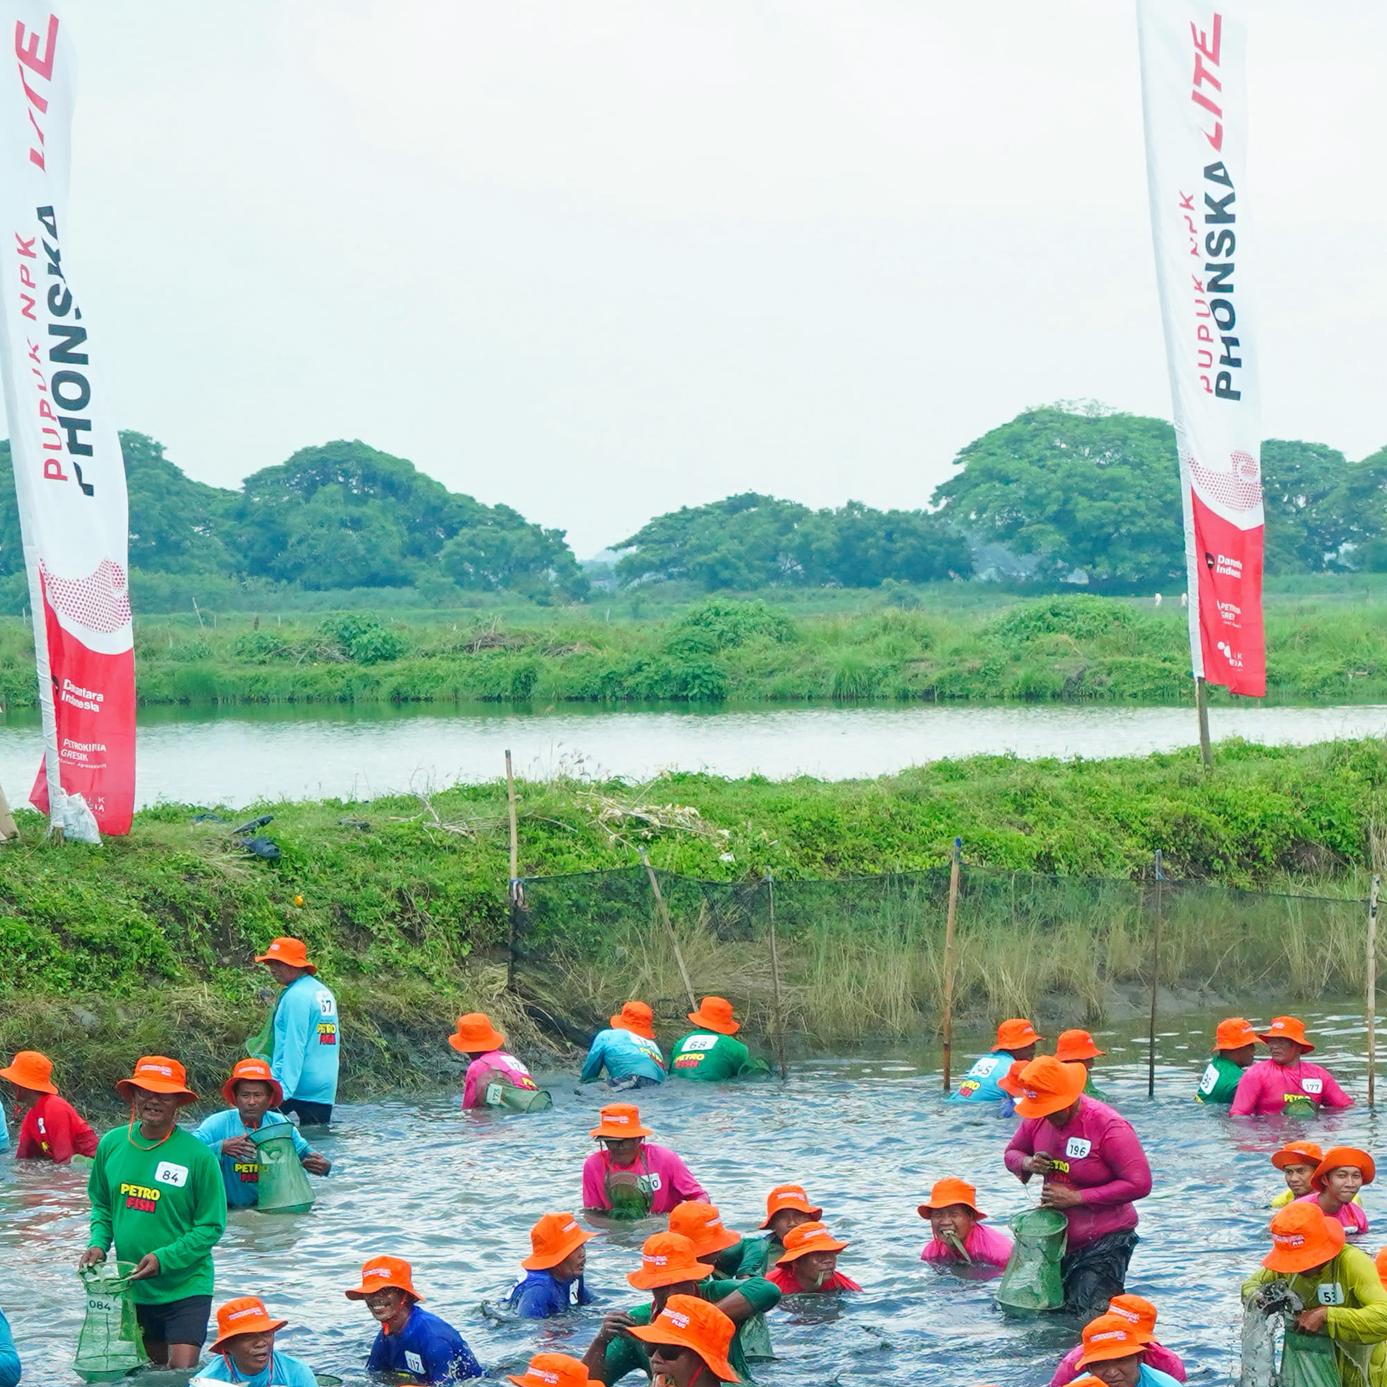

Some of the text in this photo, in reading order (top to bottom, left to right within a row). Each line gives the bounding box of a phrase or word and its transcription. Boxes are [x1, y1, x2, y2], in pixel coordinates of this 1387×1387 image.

[1191, 12, 1223, 153] LITE
[15, 233, 38, 321] NPK
[1203, 160, 1242, 402] PHONSKA
[1305, 1081, 1320, 1092] 177
[1069, 1144, 1087, 1158] 196
[161, 1169, 180, 1184] 84
[121, 1182, 161, 1201] PETRO
[125, 1197, 157, 1213] FISH
[1324, 1291, 1338, 1303] 53
[89, 1299, 112, 1312] 084
